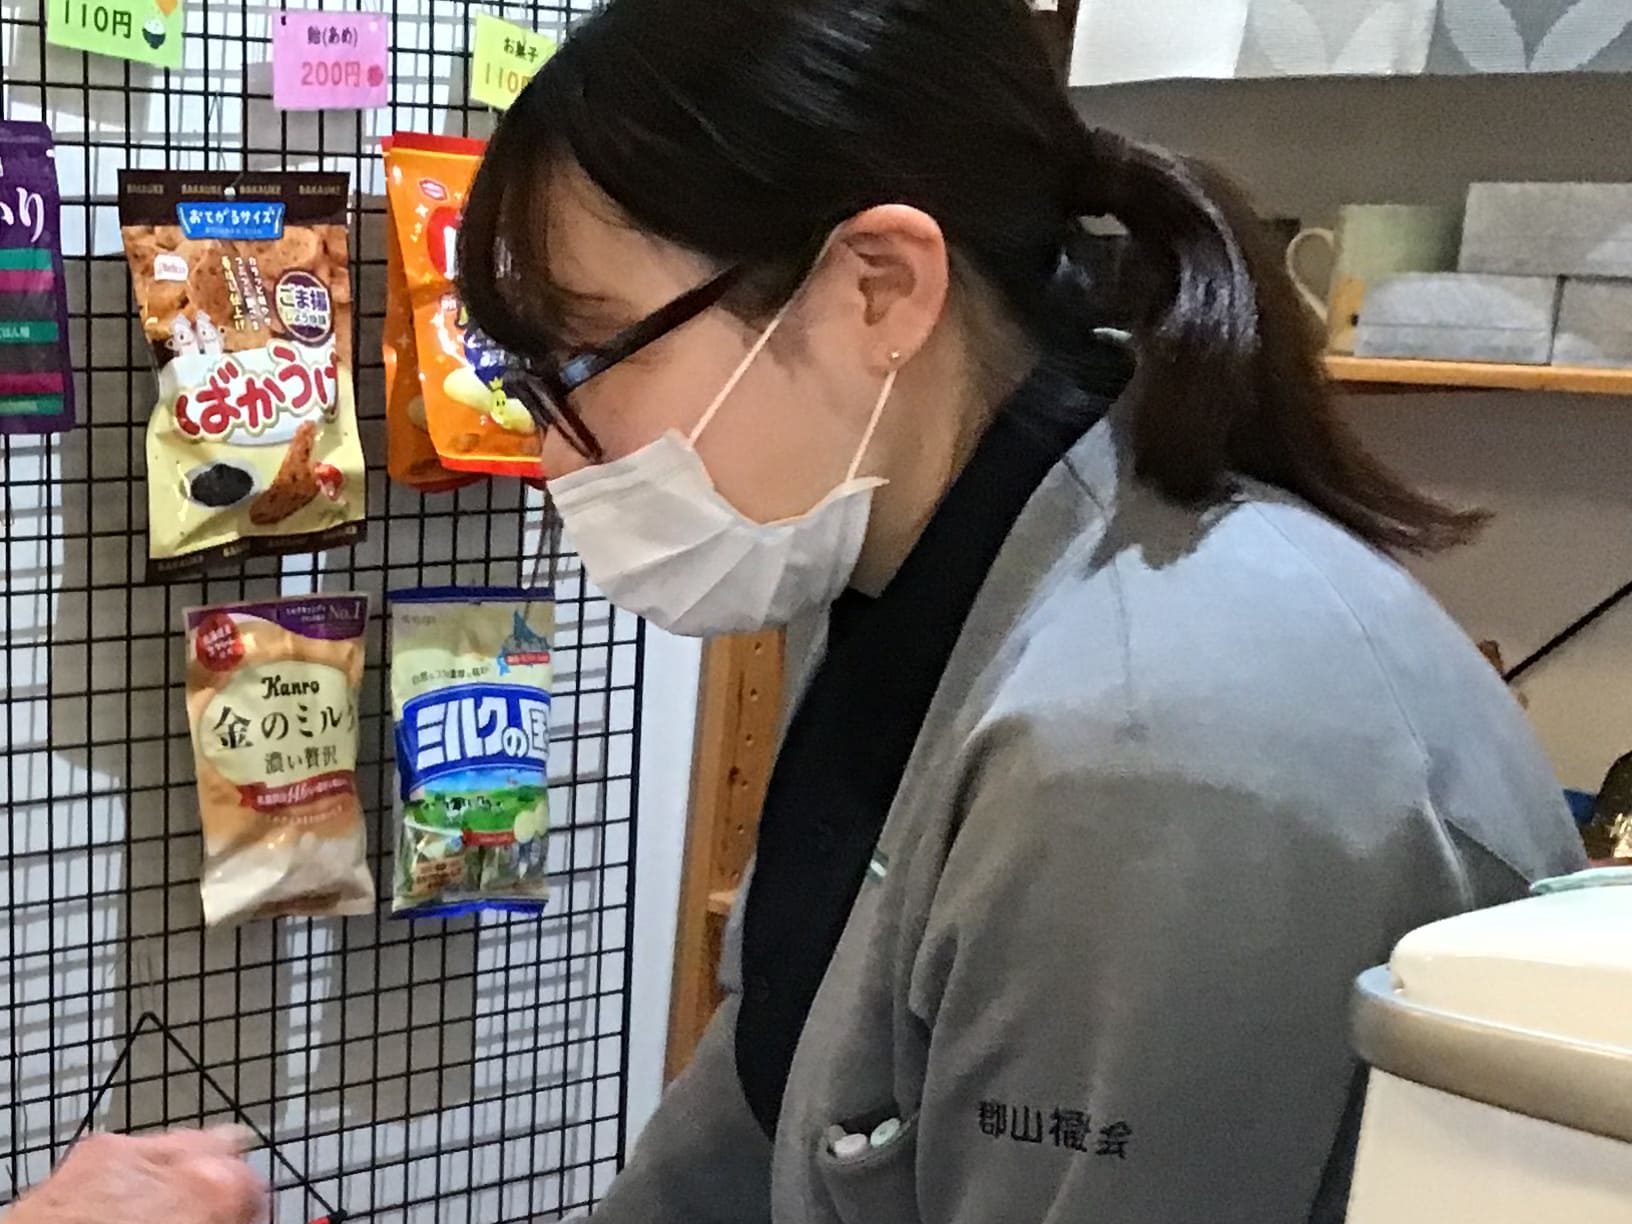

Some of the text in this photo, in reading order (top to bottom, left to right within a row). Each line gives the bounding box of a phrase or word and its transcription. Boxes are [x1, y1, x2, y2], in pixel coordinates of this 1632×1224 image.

[301, 61, 361, 88] 200円
[189, 207, 276, 227] おてがるサイズ
[260, 674, 321, 700] Kanro
